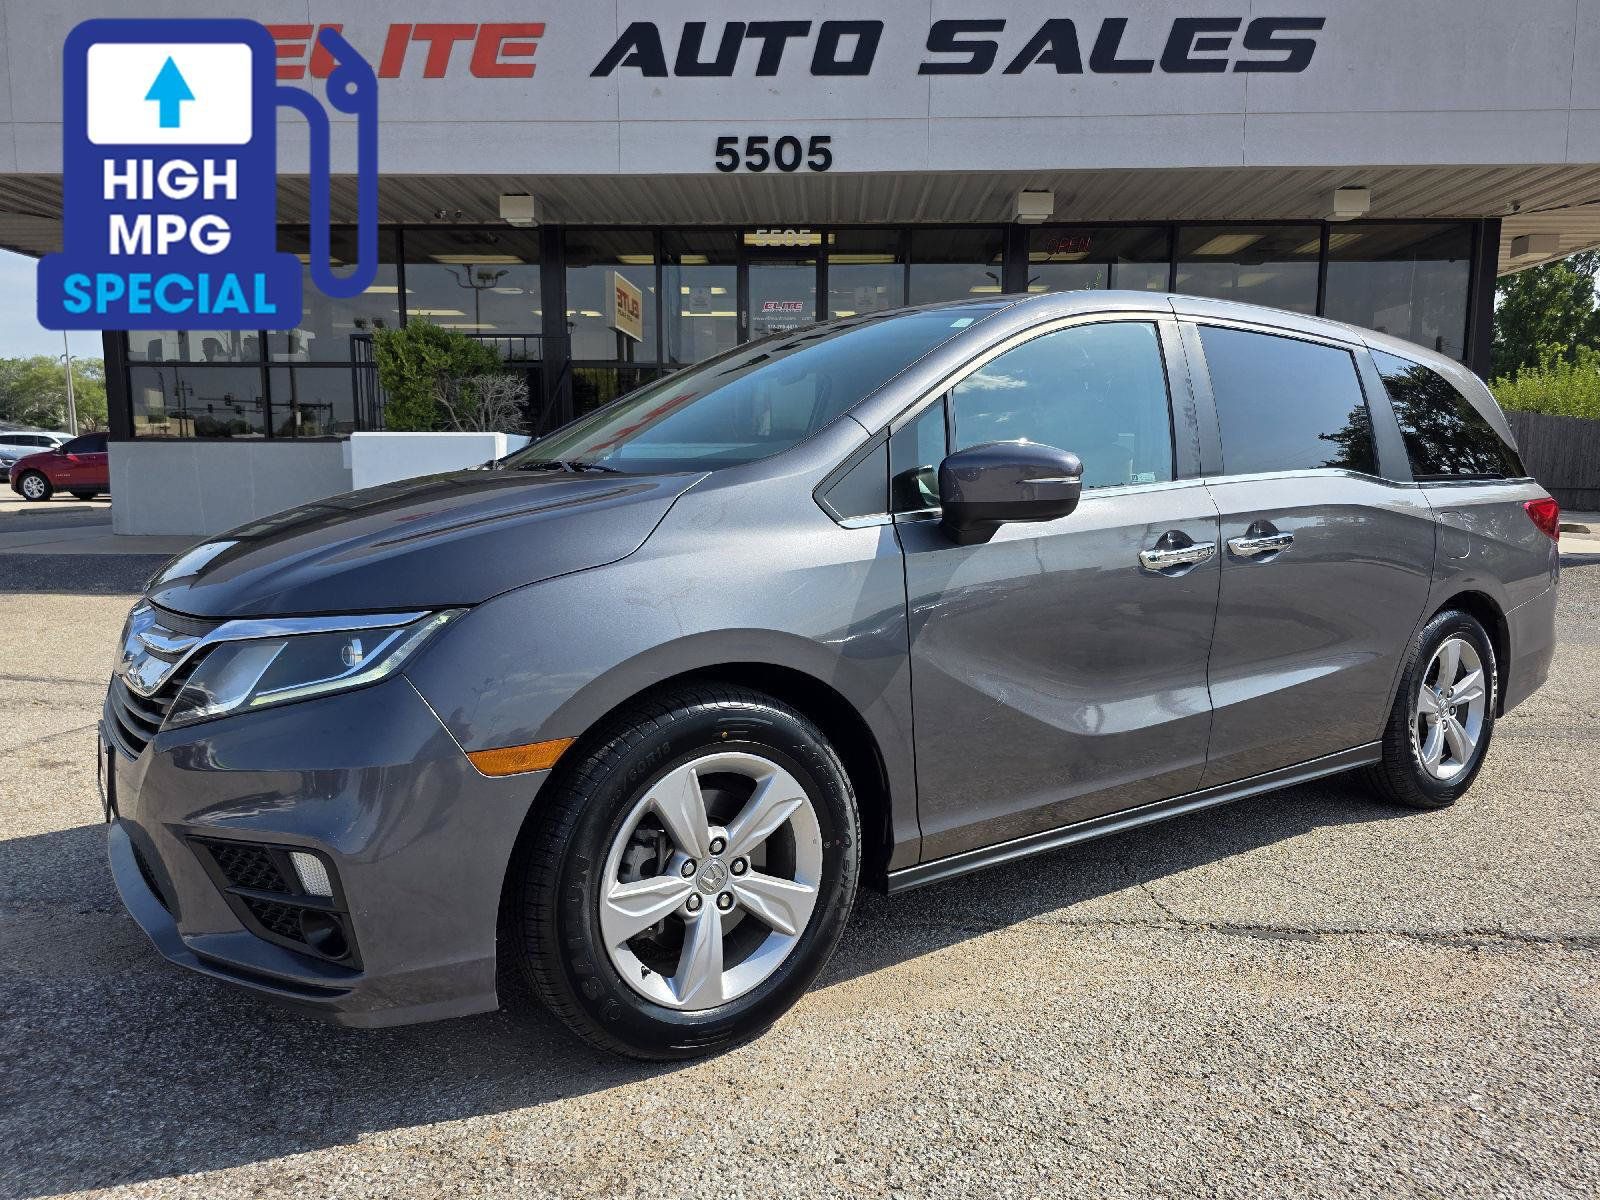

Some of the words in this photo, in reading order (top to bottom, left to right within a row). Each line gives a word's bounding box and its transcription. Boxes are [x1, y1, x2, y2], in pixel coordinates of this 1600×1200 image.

[589, 20, 884, 78] AUTO
[917, 17, 1326, 75] SALES
[714, 135, 833, 173] 5505
[755, 229, 811, 247] 5505
[1047, 237, 1091, 254] OPEN
[762, 301, 804, 310] ELITE
